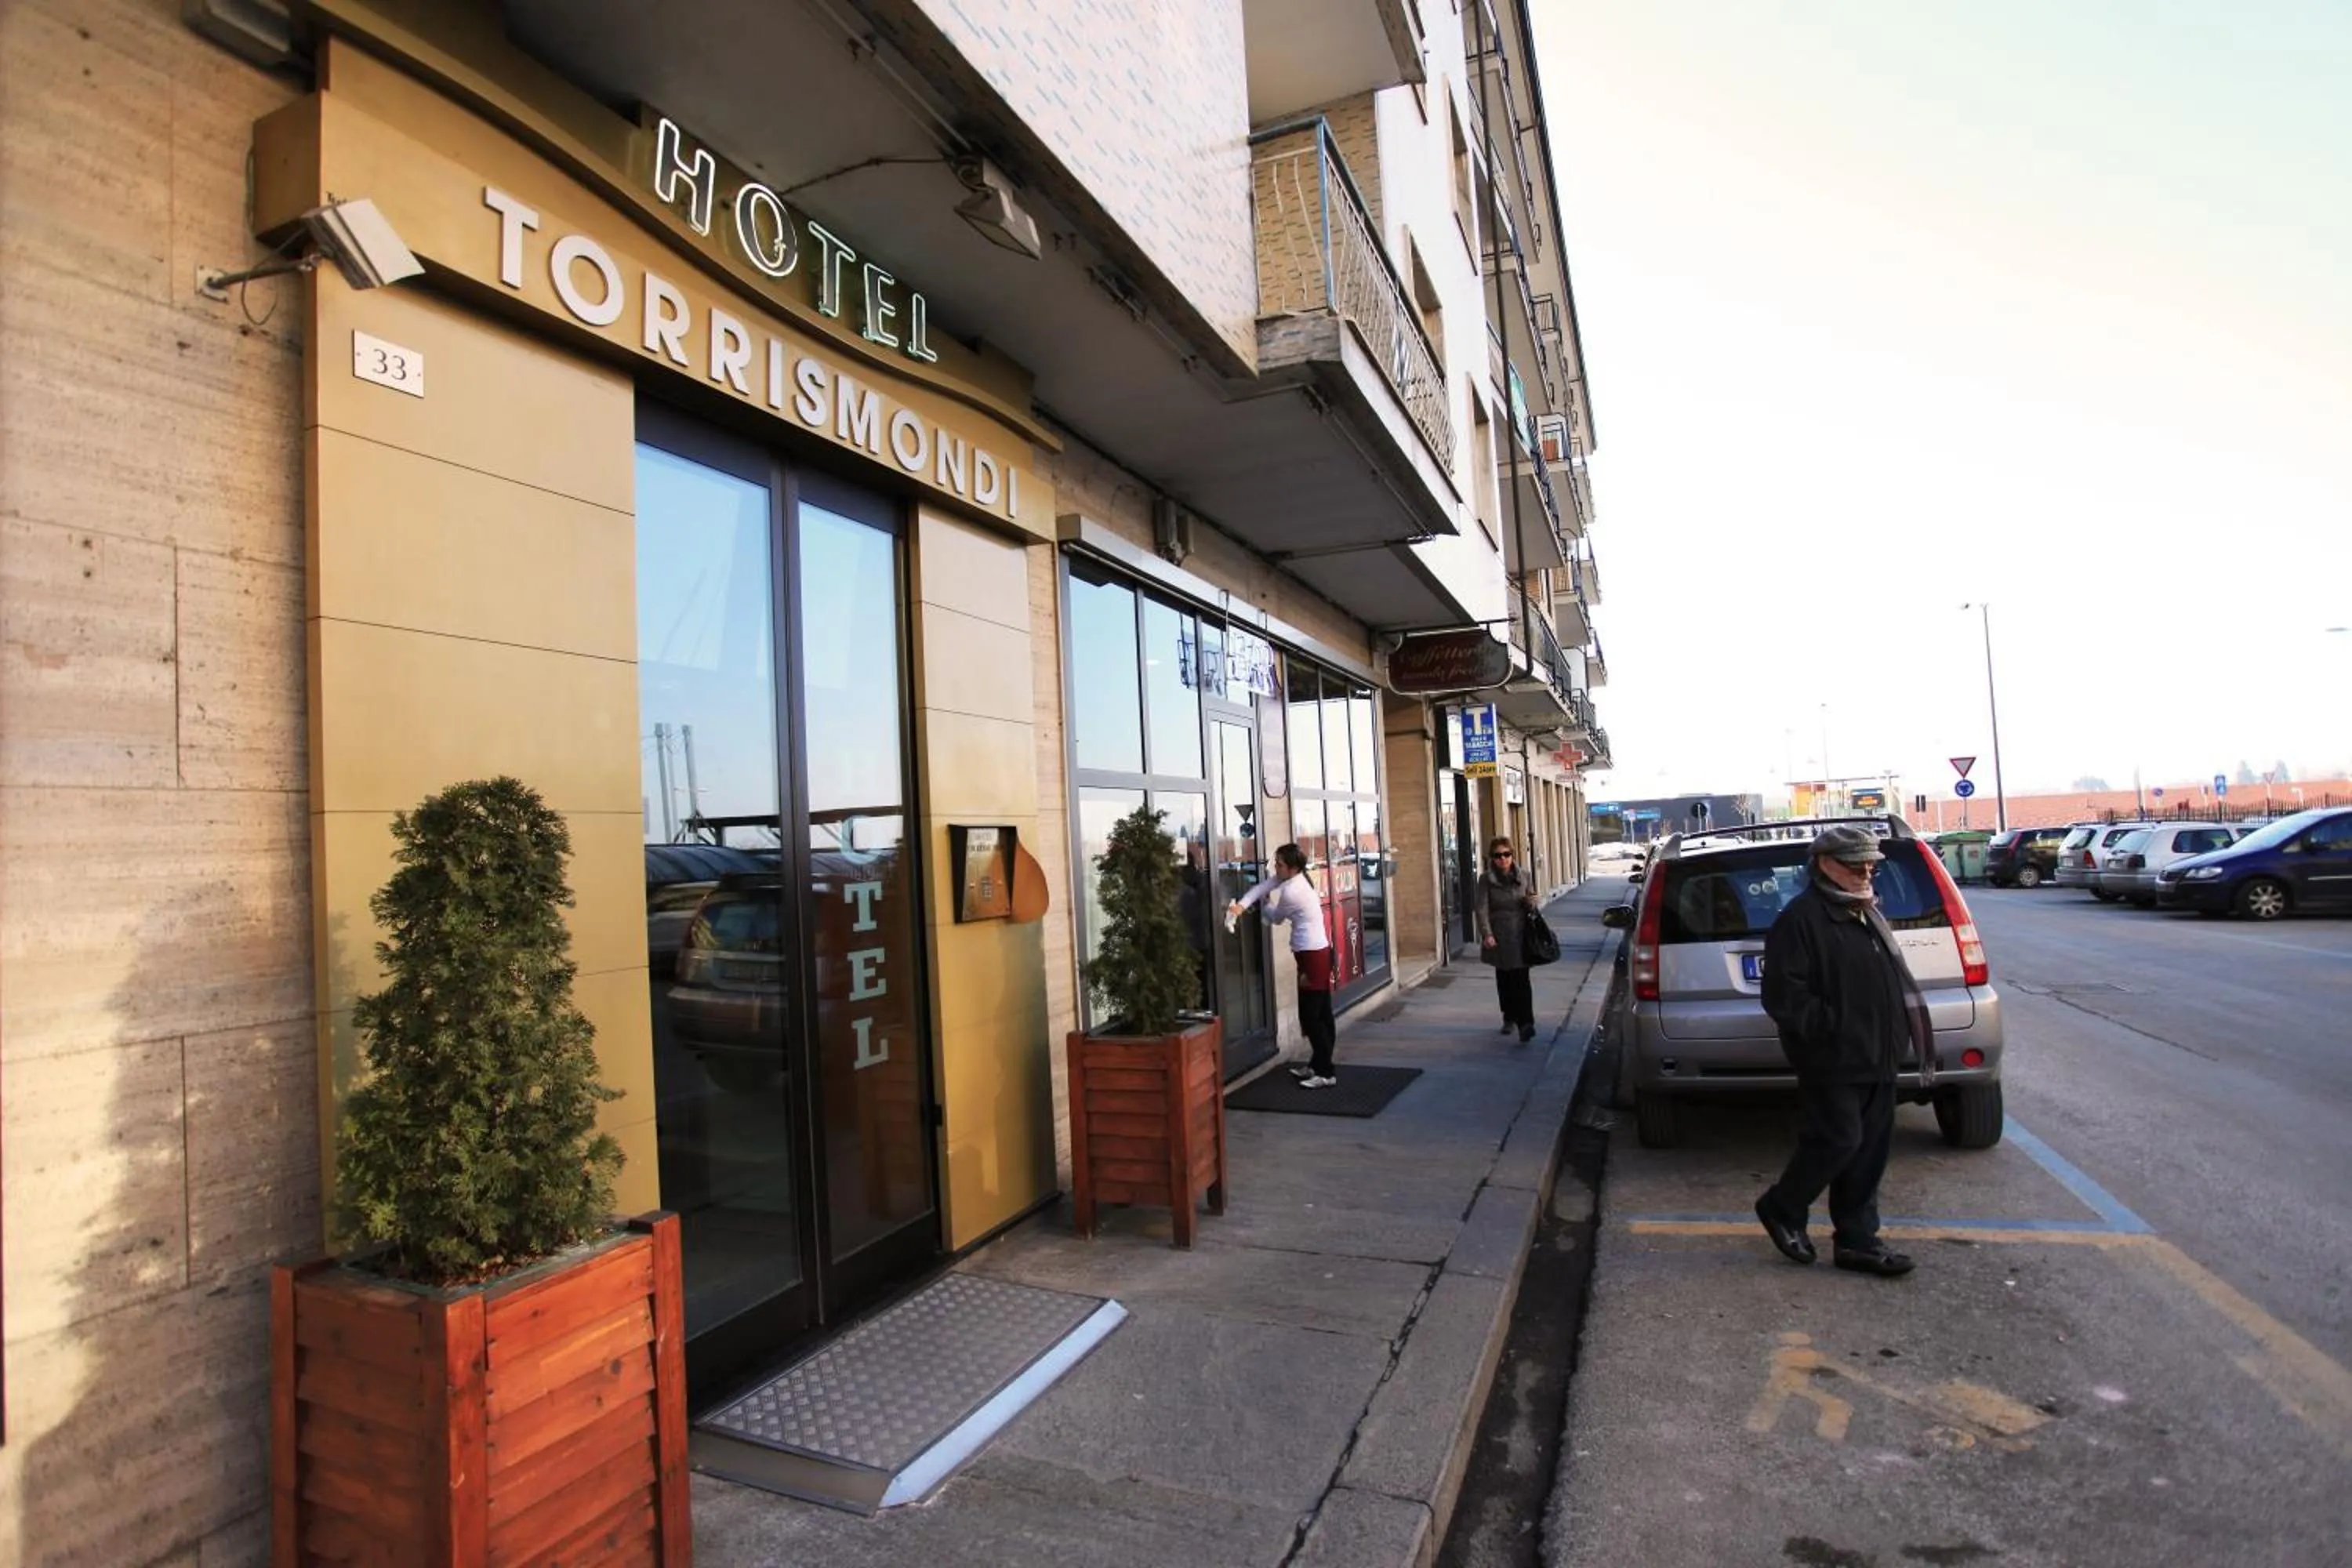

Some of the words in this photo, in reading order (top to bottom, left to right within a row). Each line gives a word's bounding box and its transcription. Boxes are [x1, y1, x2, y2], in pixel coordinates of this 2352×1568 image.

[655, 118, 938, 362] HOTEL
[372, 348, 407, 381] 33
[485, 185, 1018, 518] TORRISMONDI
[1465, 707, 1488, 735] T
